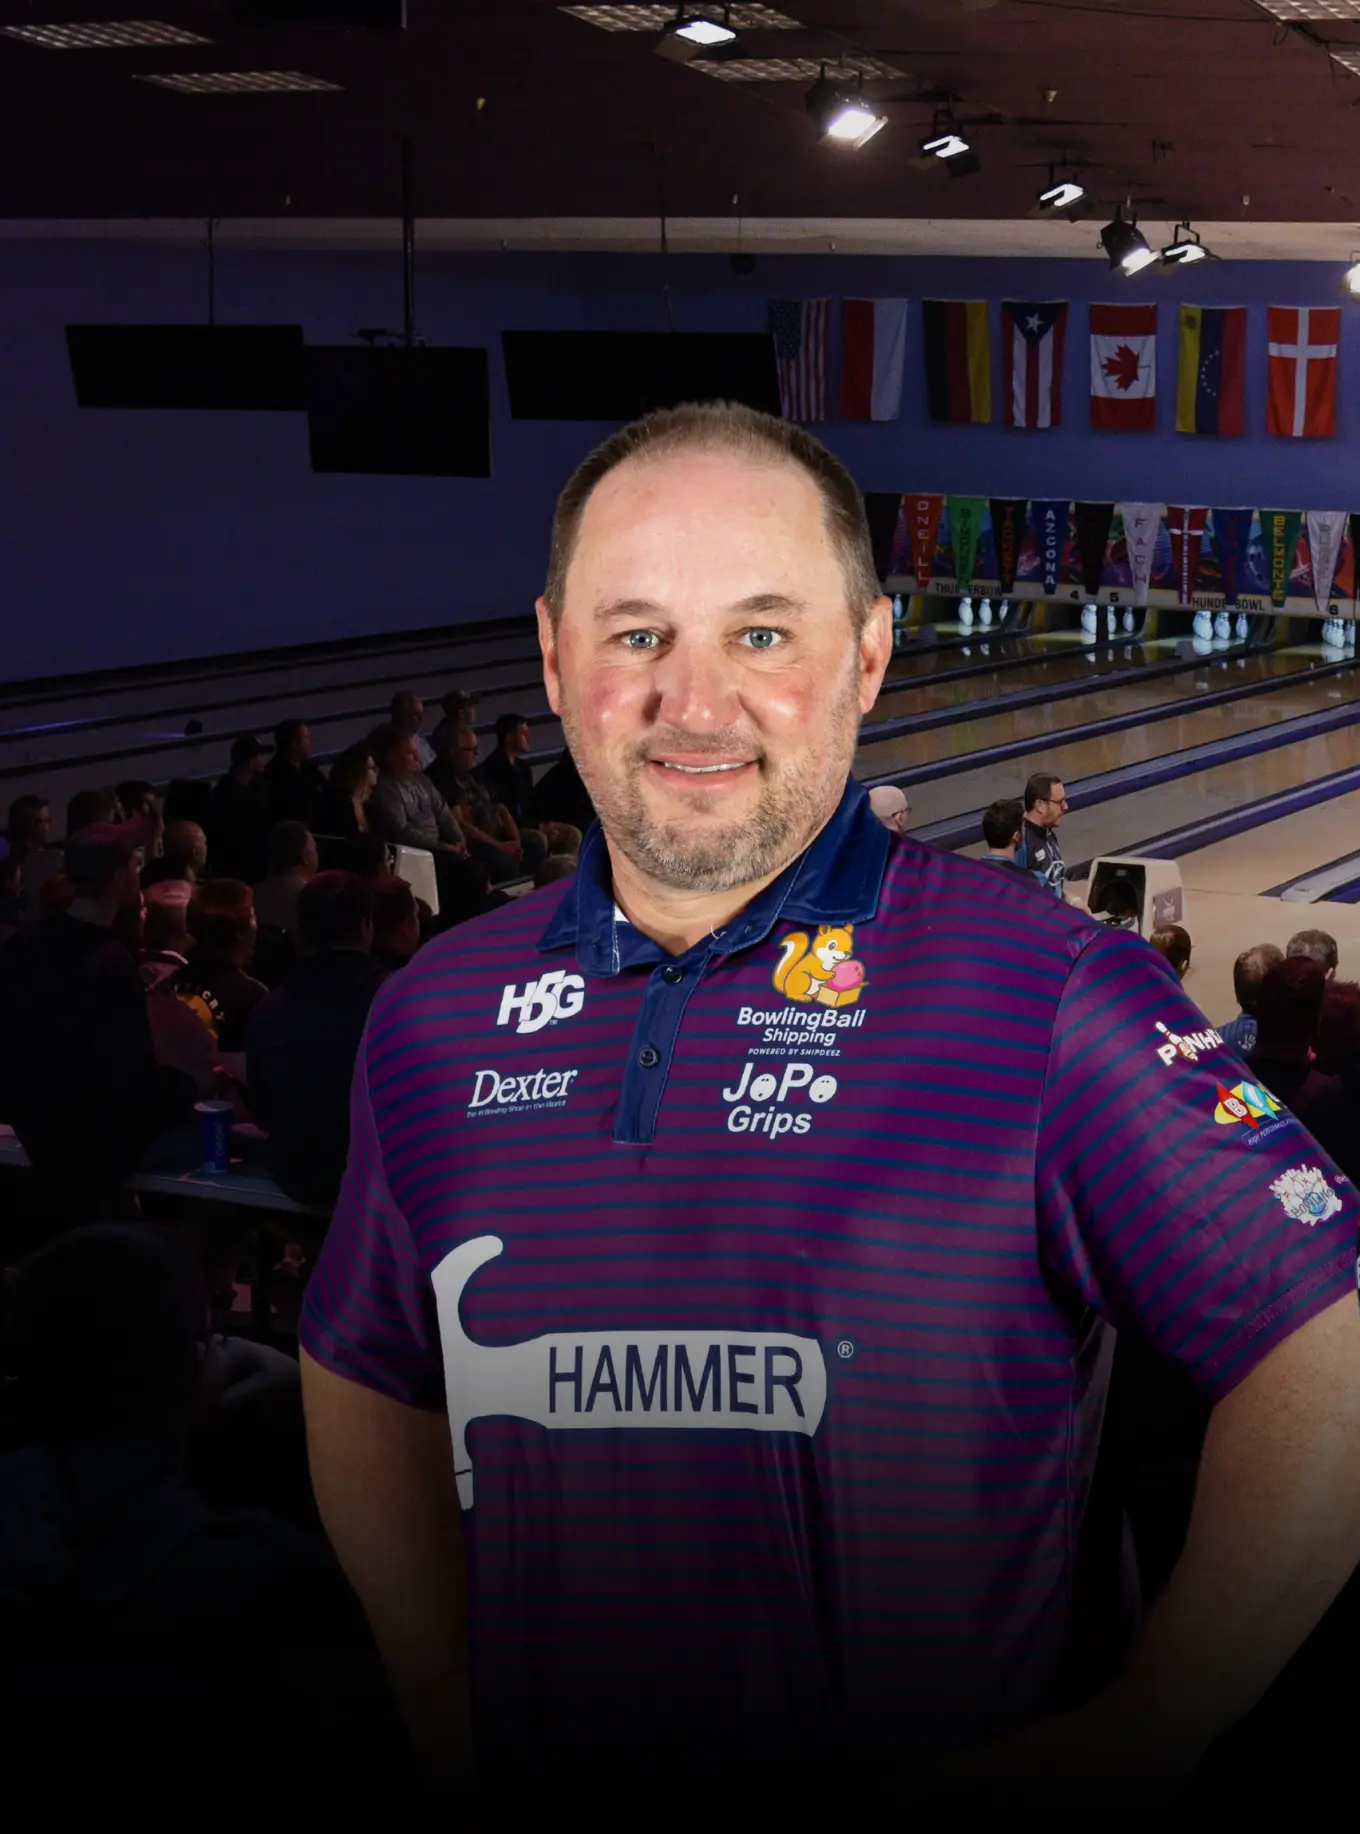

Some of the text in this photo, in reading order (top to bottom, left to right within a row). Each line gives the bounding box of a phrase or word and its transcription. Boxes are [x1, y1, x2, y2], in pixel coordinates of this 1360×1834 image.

[1044, 509, 1056, 585] AZCONA
[1134, 518, 1147, 584] FACH
[1070, 590, 1079, 600] 4
[1192, 597, 1265, 611] HUNDEBOWL
[1329, 605, 1338, 615] 6
[496, 969, 585, 1033] H5G
[736, 1007, 866, 1030] BowlingBall
[762, 1028, 836, 1046] Shipping
[468, 1068, 578, 1108] Dexter
[727, 1105, 812, 1140] Grips
[548, 1344, 806, 1418] HAMMER
